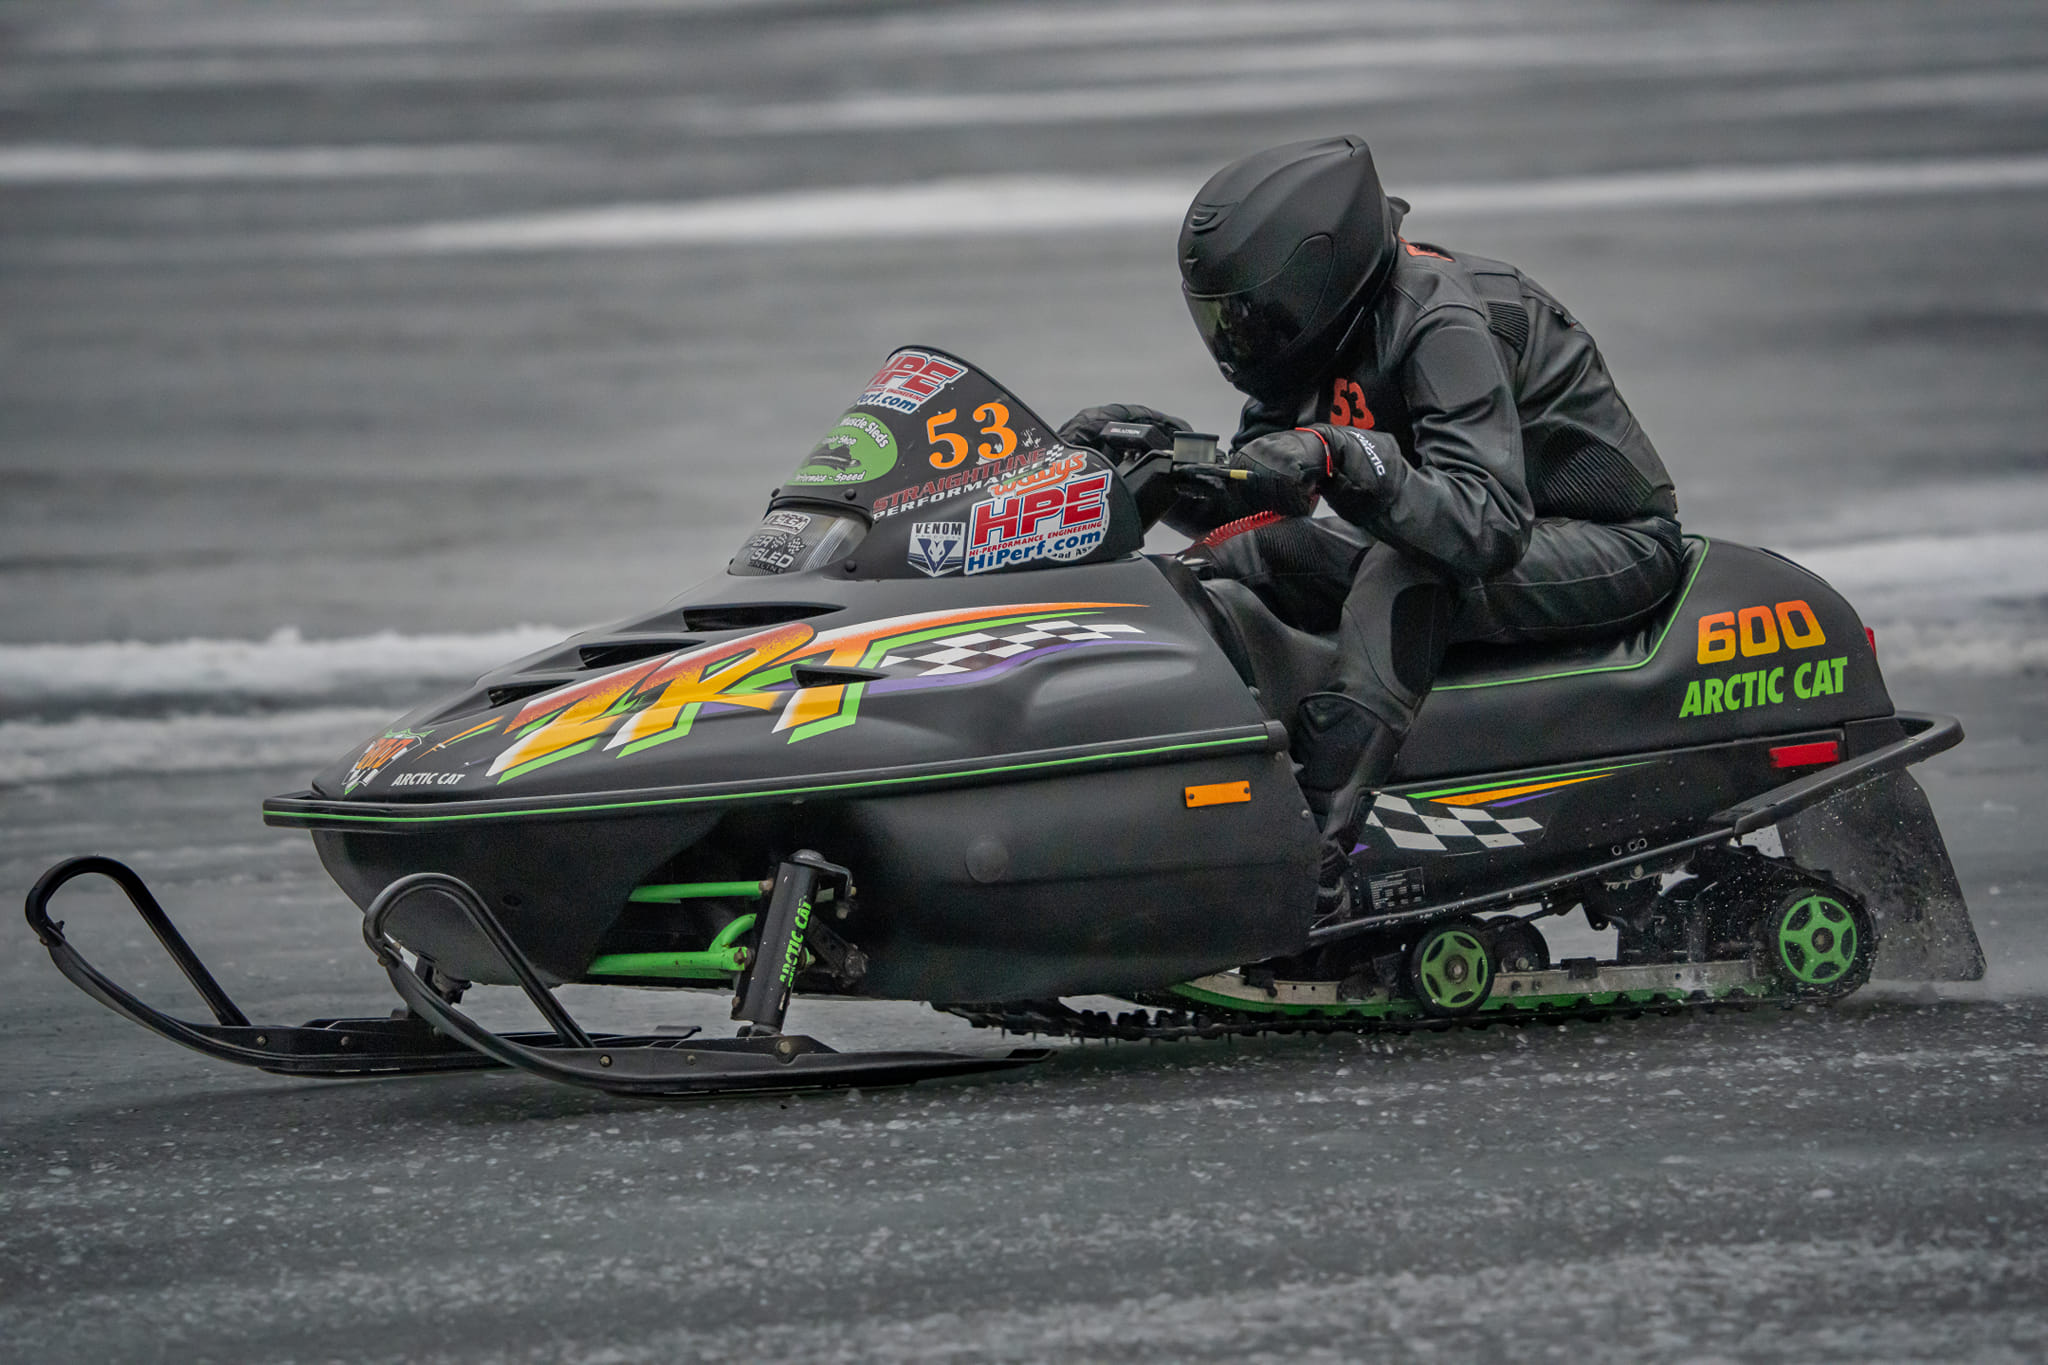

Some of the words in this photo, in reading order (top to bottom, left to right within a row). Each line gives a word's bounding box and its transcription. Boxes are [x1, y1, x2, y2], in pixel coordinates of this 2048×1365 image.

[1330, 377, 1375, 430] 53
[864, 421, 890, 449] Sleds
[926, 402, 1018, 470] 53
[834, 470, 866, 483] Speed
[873, 448, 1047, 514] STRAIGHTLINE
[873, 460, 1048, 522] PERFORMANCE
[915, 522, 962, 536] VENOM
[972, 474, 1109, 548] HPE
[750, 548, 795, 568] SLED
[967, 530, 1101, 572] HiPerf.com
[968, 535, 1044, 557] HI-PERFORMANCE
[1047, 521, 1103, 539] ENGINEERING
[1697, 599, 1826, 665] 600
[486, 612, 890, 785] ZRT
[1679, 666, 1784, 718] ARCTIC
[1793, 656, 1848, 700] CAT
[391, 772, 438, 787] ARCTIC
[437, 773, 466, 786] CAT
[779, 930, 804, 988] ARCTIC
